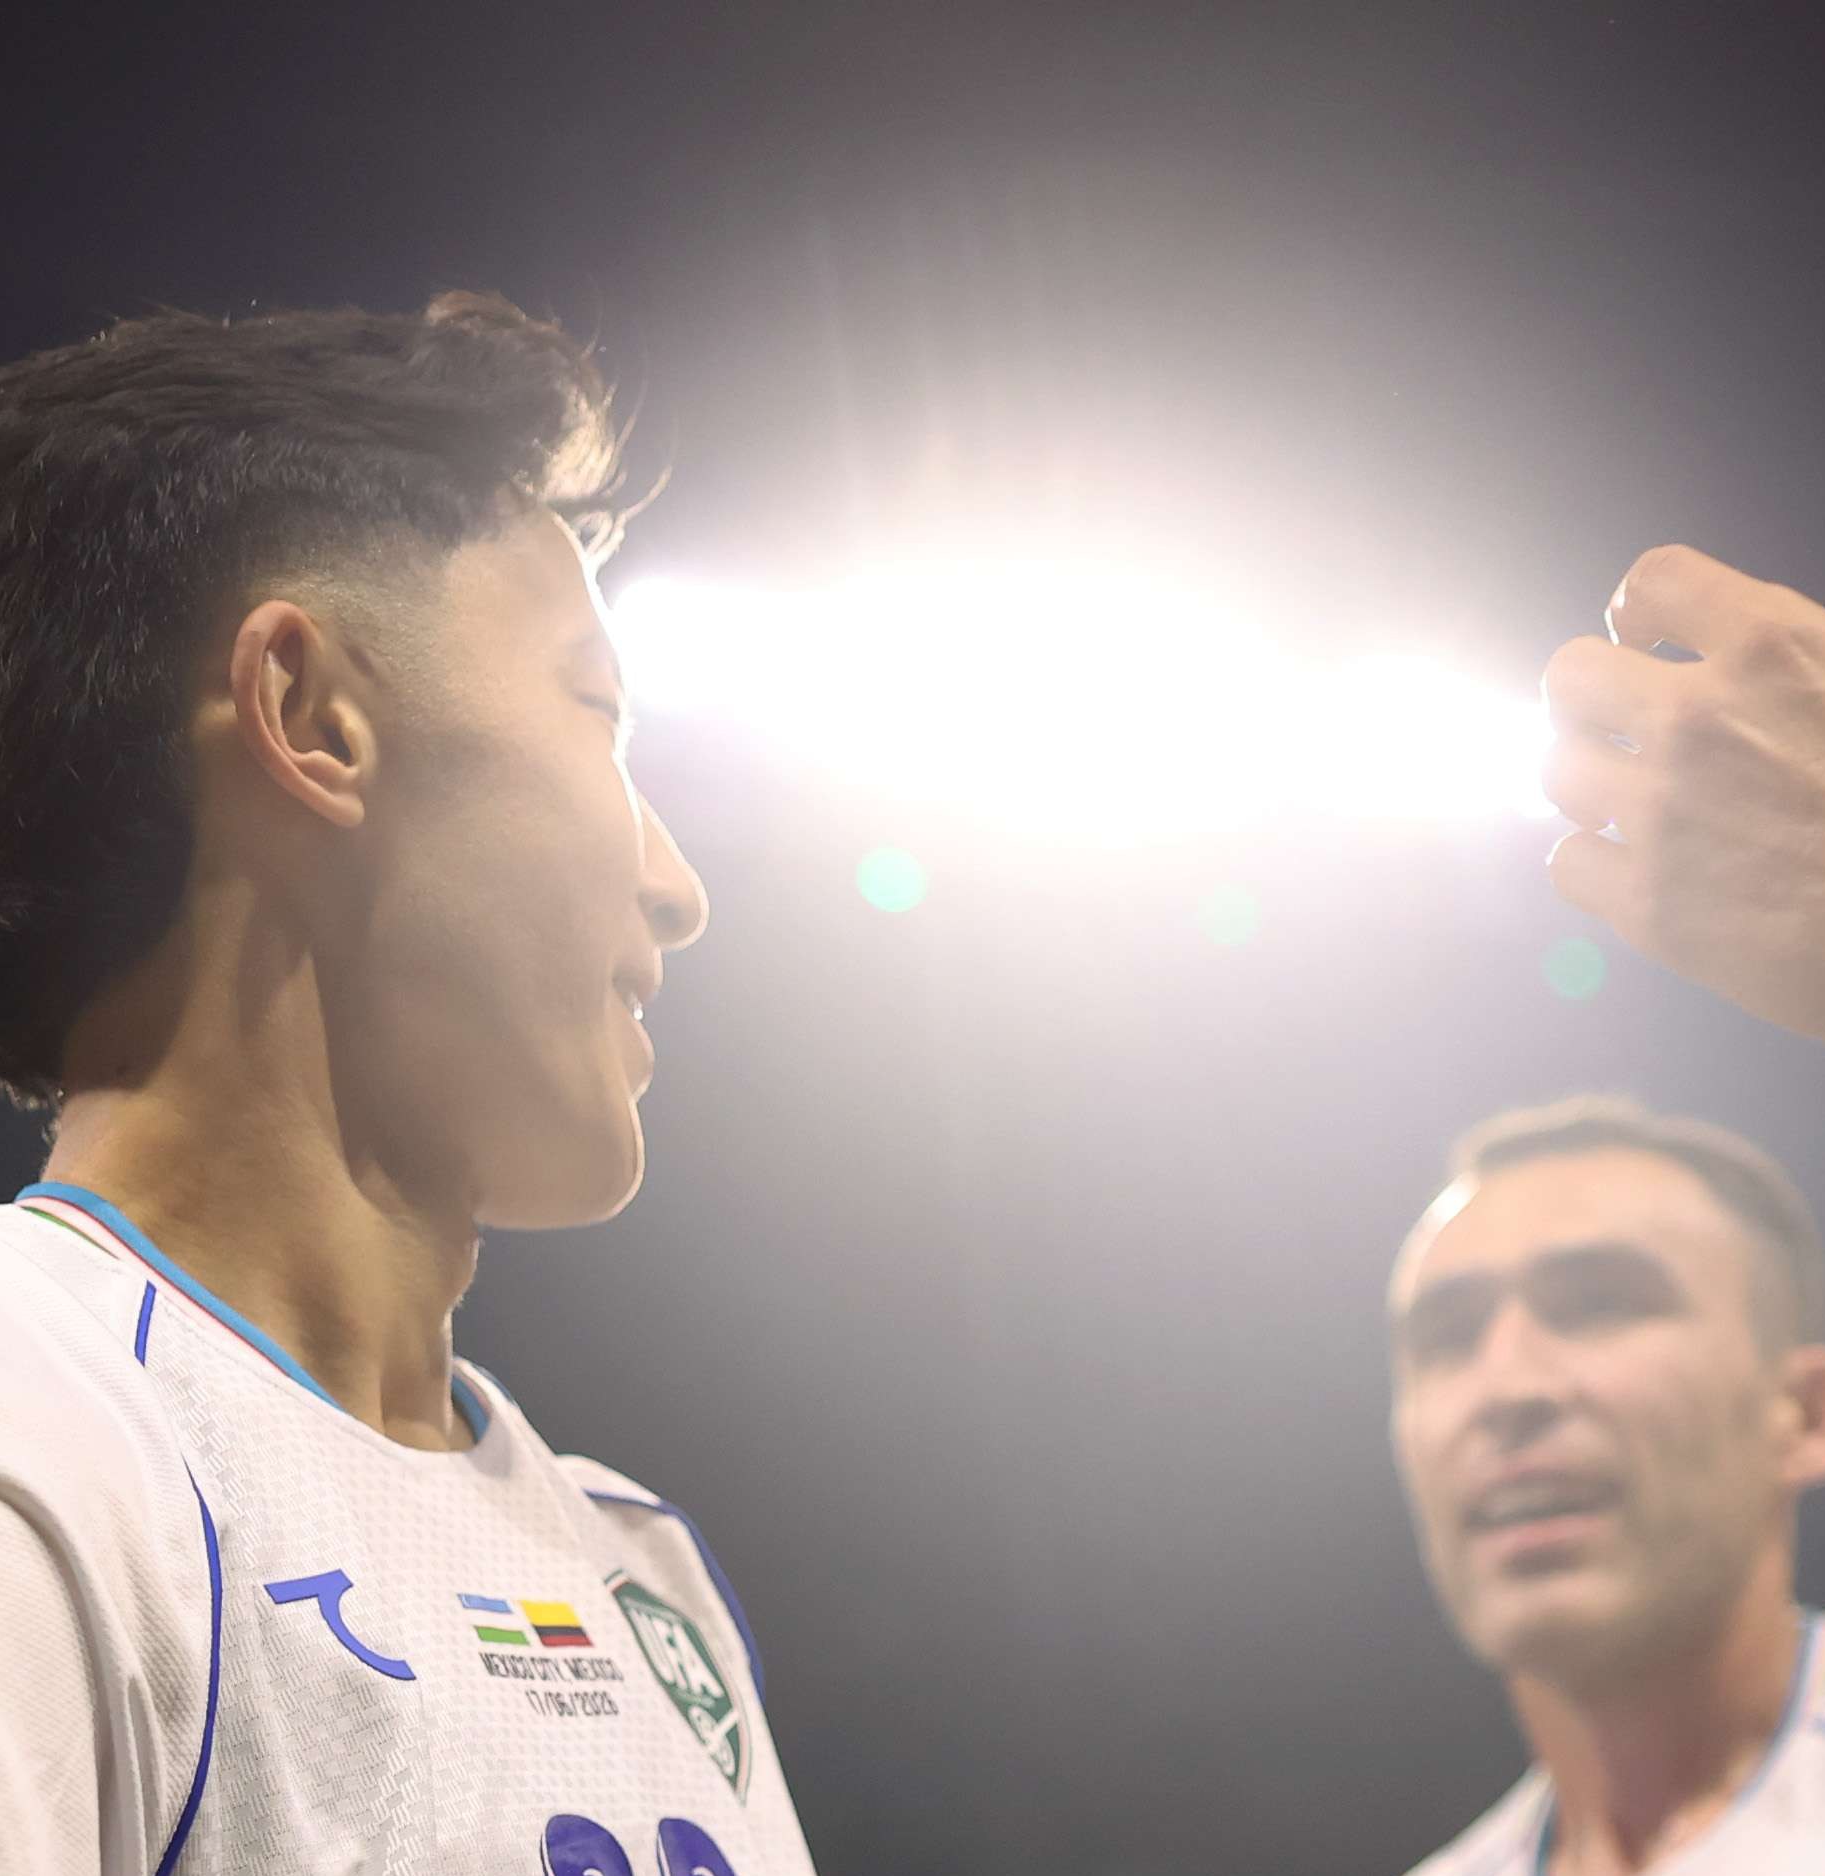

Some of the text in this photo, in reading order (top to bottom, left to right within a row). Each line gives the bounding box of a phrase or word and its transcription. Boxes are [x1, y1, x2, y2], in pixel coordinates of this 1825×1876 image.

[478, 1652, 536, 1680] MEXICO
[563, 1657, 625, 1682] MEXICO
[525, 1690, 620, 1717] 17/06/2026
